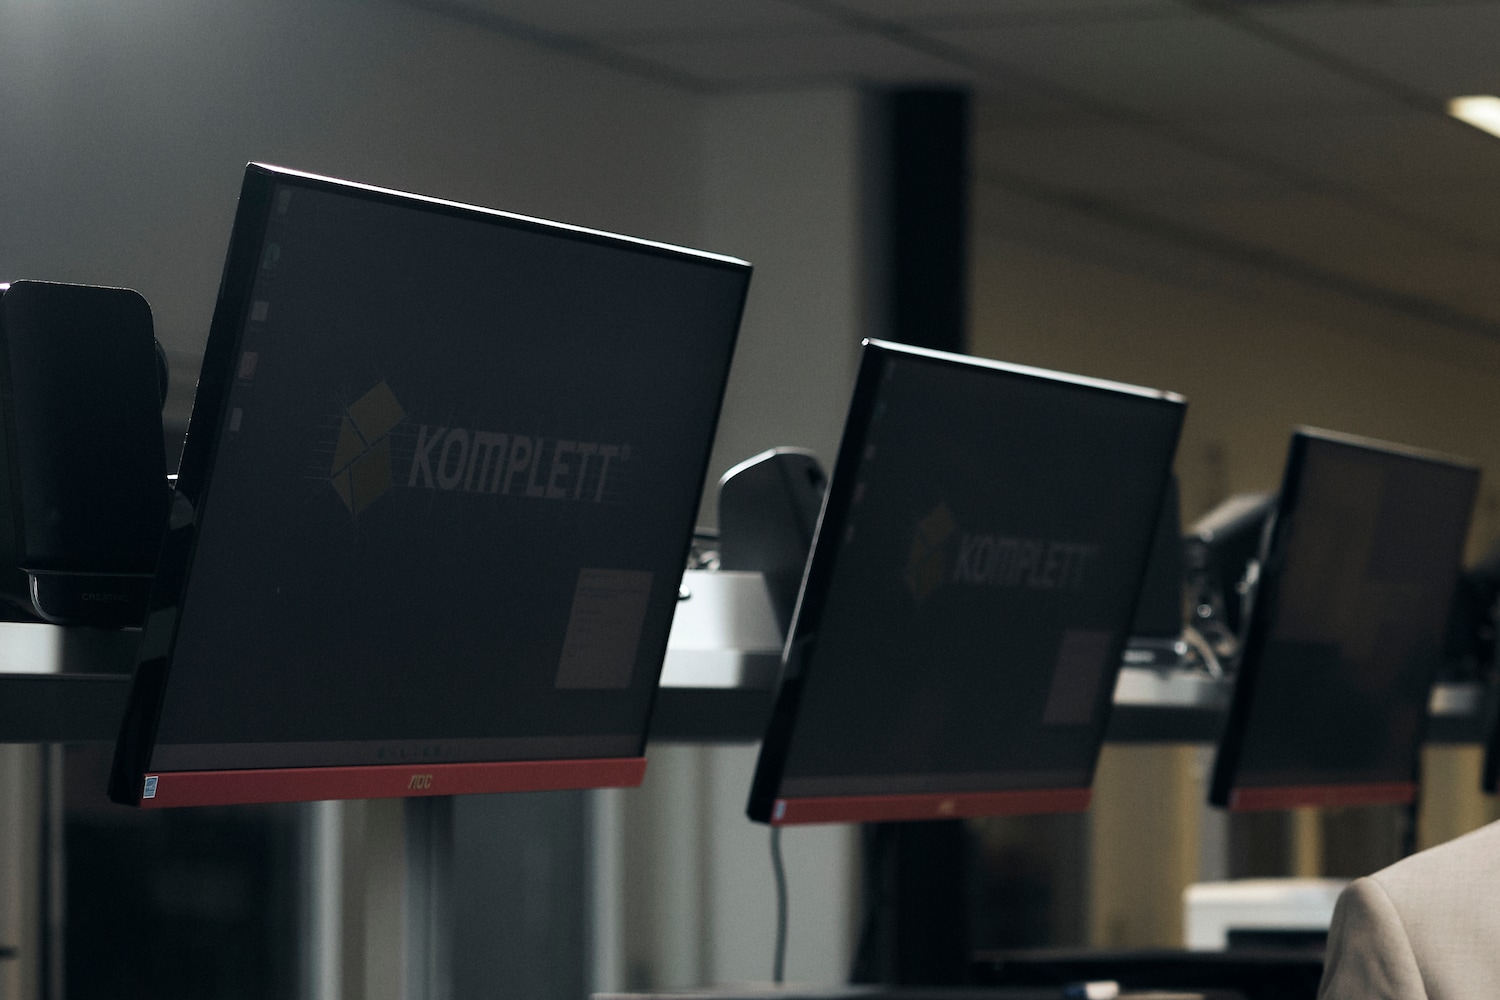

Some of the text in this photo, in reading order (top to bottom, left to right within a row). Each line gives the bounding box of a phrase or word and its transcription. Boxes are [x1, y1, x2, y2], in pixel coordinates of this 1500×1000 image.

[408, 424, 619, 502] KOMPLETT
[953, 531, 1098, 590] KOMPLETT
[81, 593, 129, 602] CREATIVE
